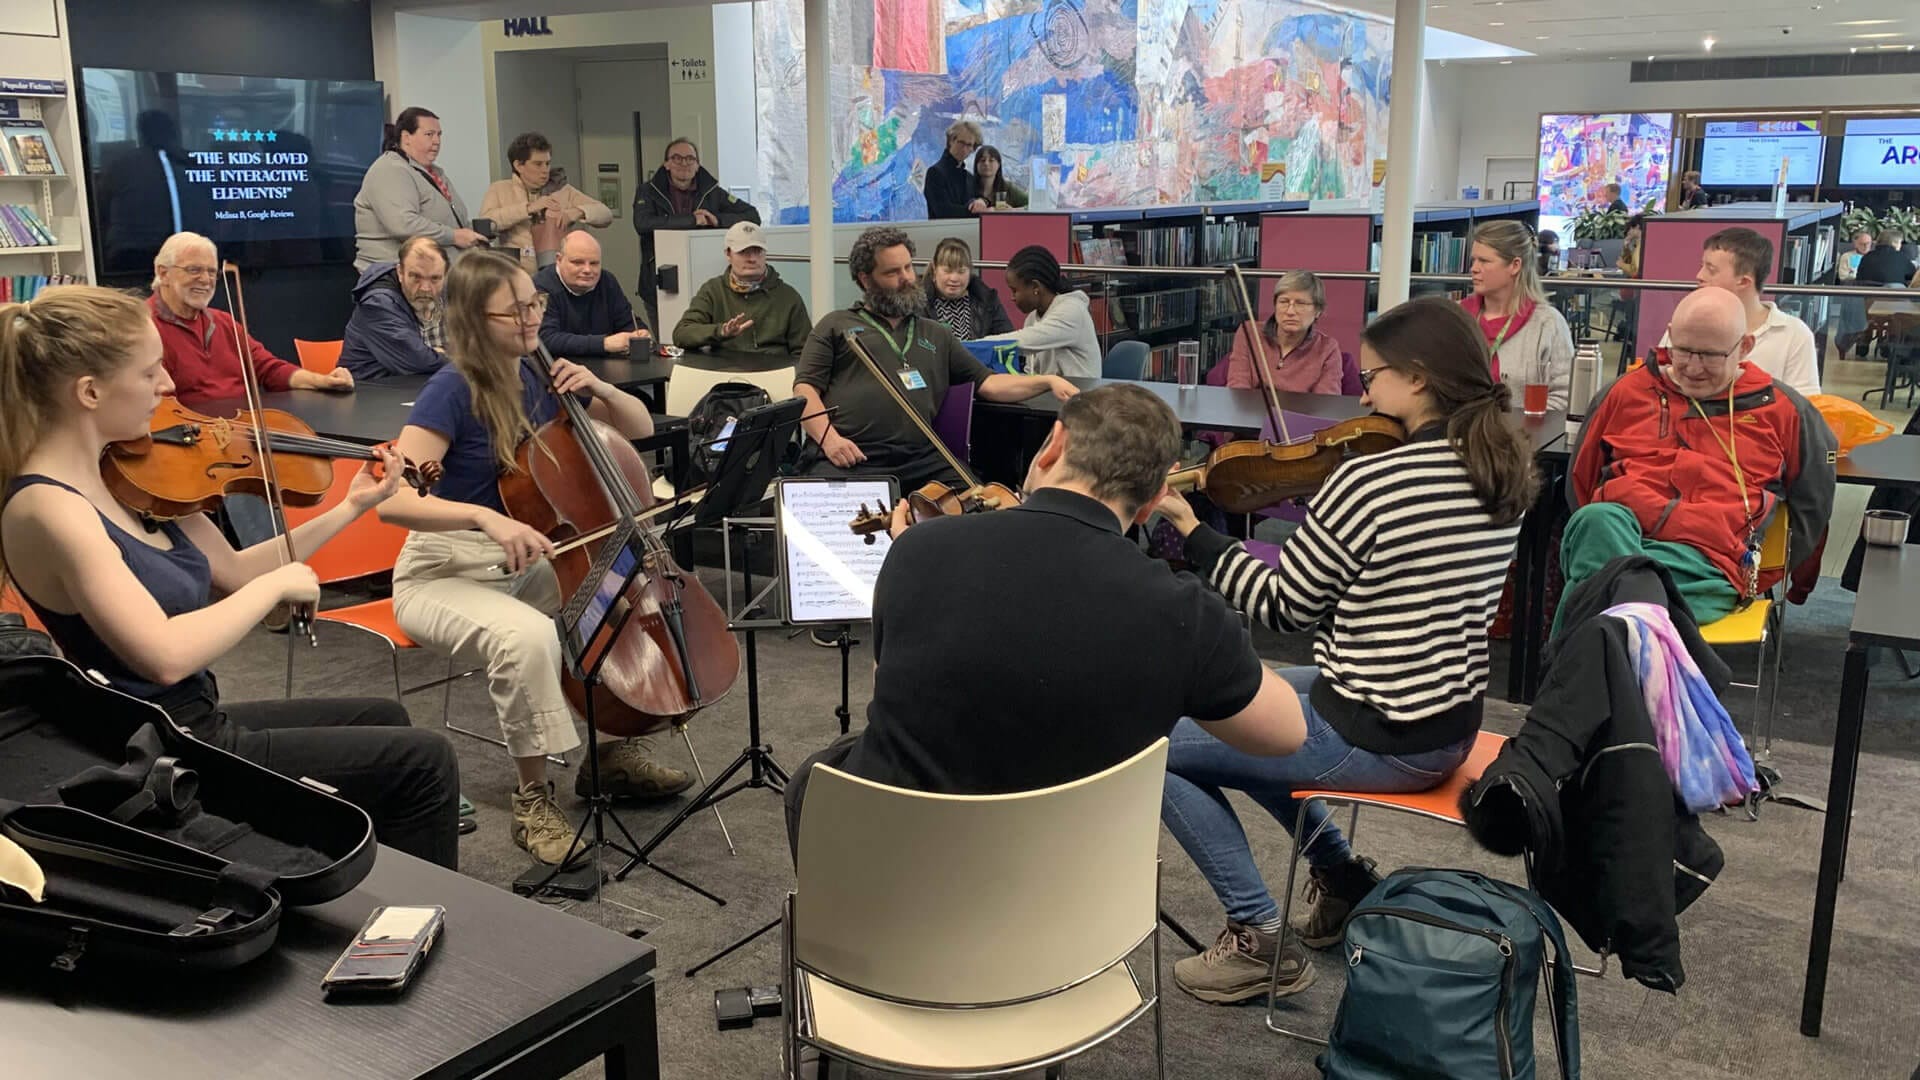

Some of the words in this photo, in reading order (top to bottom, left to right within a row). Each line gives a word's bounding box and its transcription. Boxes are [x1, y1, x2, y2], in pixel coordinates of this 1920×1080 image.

[504, 17, 552, 37] HALL
[681, 59, 706, 67] Toilets
[2, 81, 28, 89] Popular
[228, 152, 261, 165] KIDS
[265, 152, 308, 165] LOVED
[1881, 145, 1920, 165] AR
[185, 169, 216, 182] THE
[220, 169, 309, 182] INTERACTIVE
[215, 211, 239, 219] Melissa
[247, 210, 269, 220] Google
[270, 210, 294, 218] Reviews
